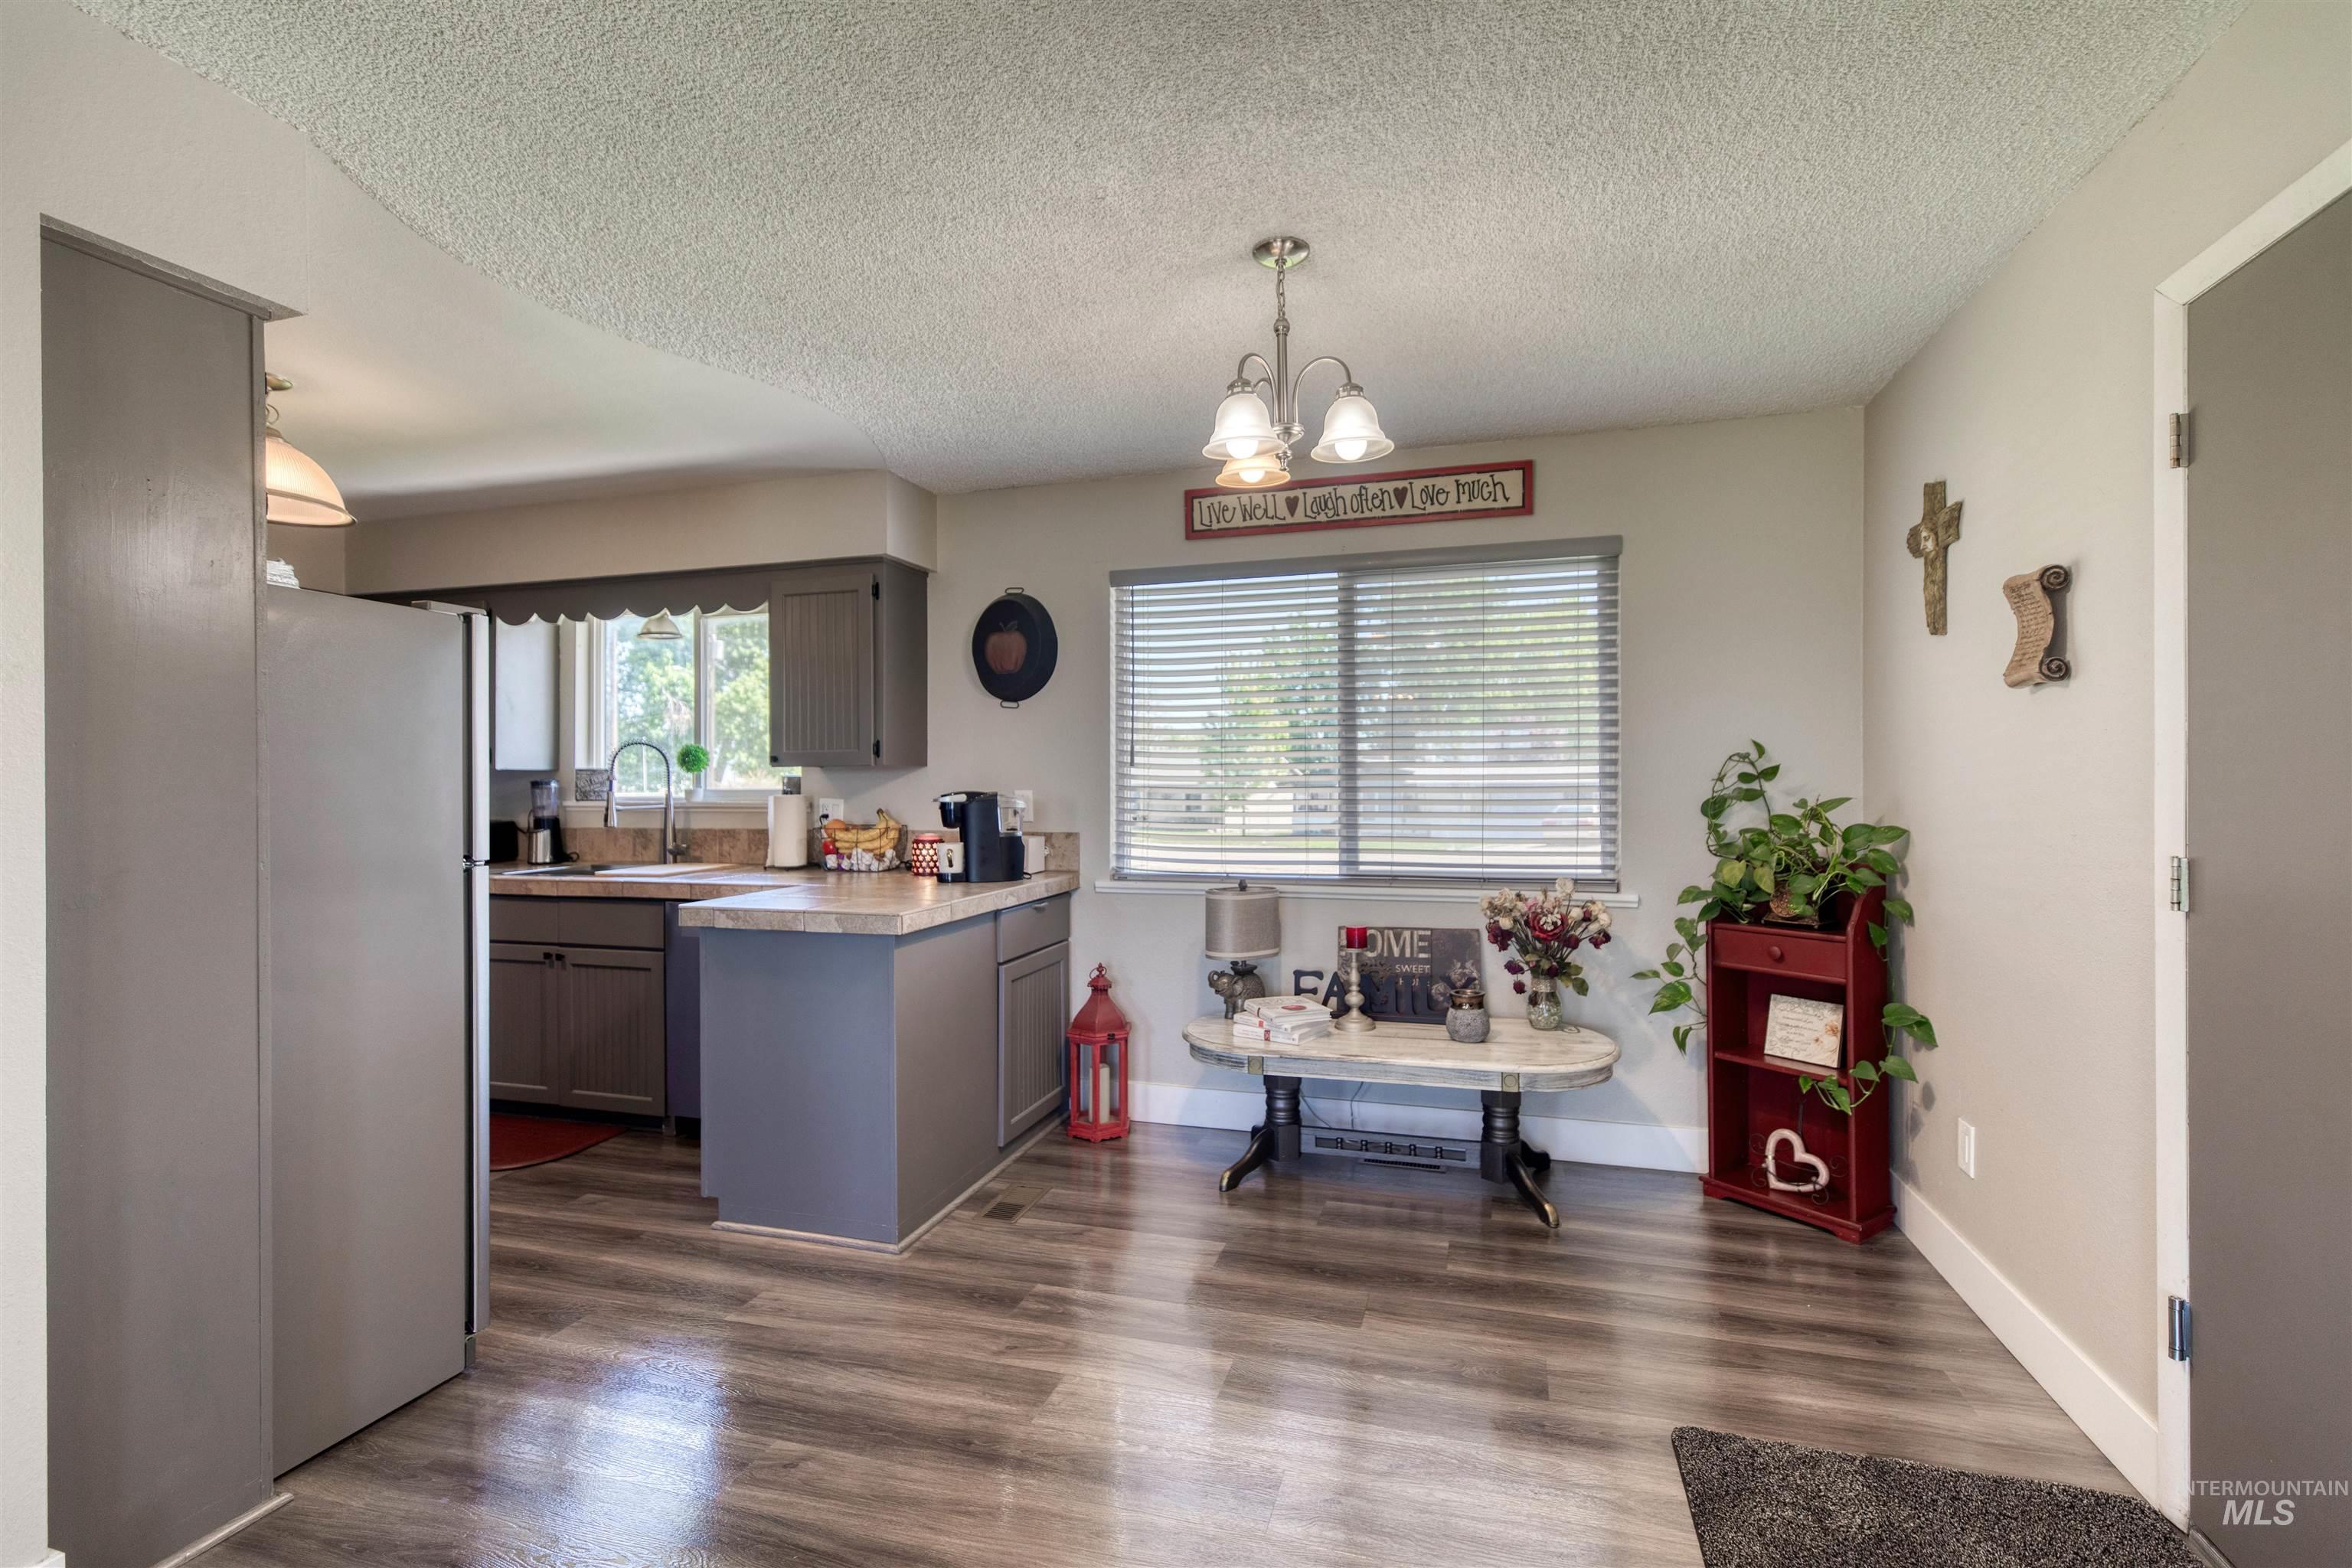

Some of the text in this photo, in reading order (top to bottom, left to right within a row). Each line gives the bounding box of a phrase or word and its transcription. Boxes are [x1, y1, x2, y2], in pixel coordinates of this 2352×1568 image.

[1302, 487, 1348, 519] Laugh
[1350, 485, 1395, 514] often
[1408, 481, 1451, 511] Love
[1340, 929, 1432, 958] OME
[1395, 964, 1431, 975] SWEET
